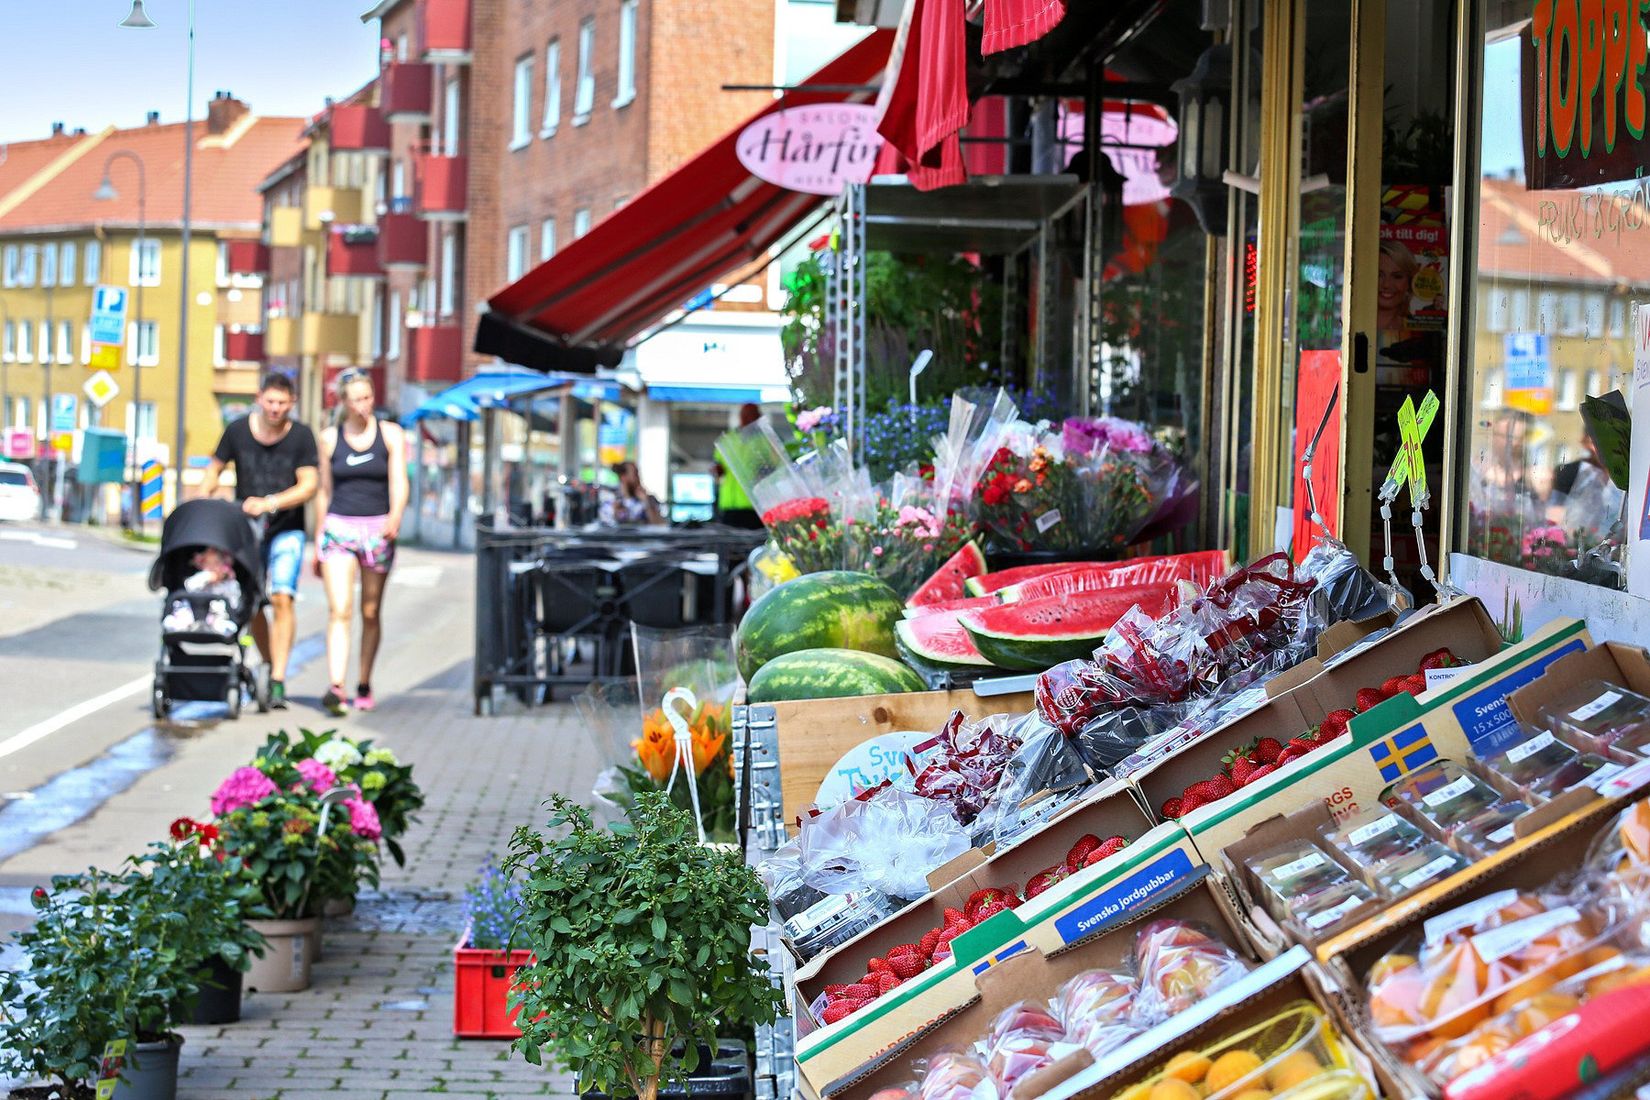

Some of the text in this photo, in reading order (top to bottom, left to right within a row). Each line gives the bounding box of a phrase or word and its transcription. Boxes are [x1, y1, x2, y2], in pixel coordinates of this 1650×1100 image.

[799, 112, 880, 124] SALON
[1537, 191, 1592, 245] FRUKT
[1396, 229, 1413, 240] till
[1416, 229, 1438, 242] dig!
[1474, 693, 1506, 717] Svens
[1473, 709, 1512, 734] 15 x 500
[1077, 903, 1120, 932] Svenska
[1118, 869, 1176, 911] jordgubbar
